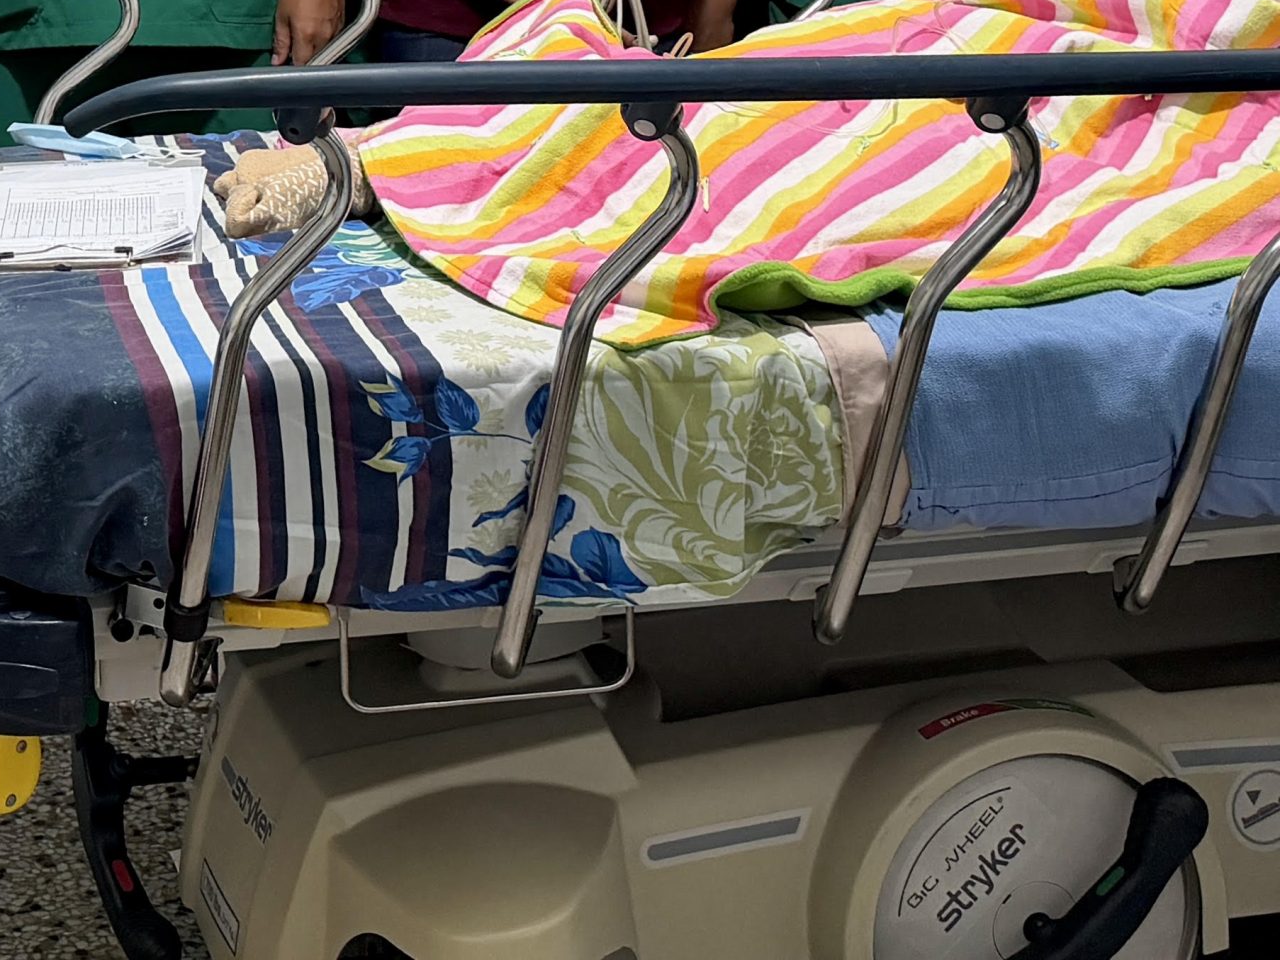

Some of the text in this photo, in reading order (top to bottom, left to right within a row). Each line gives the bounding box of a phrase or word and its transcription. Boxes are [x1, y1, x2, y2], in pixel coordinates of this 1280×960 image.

[940, 708, 981, 727] Brake
[231, 775, 273, 844] stryker
[936, 822, 1027, 933] stryker
